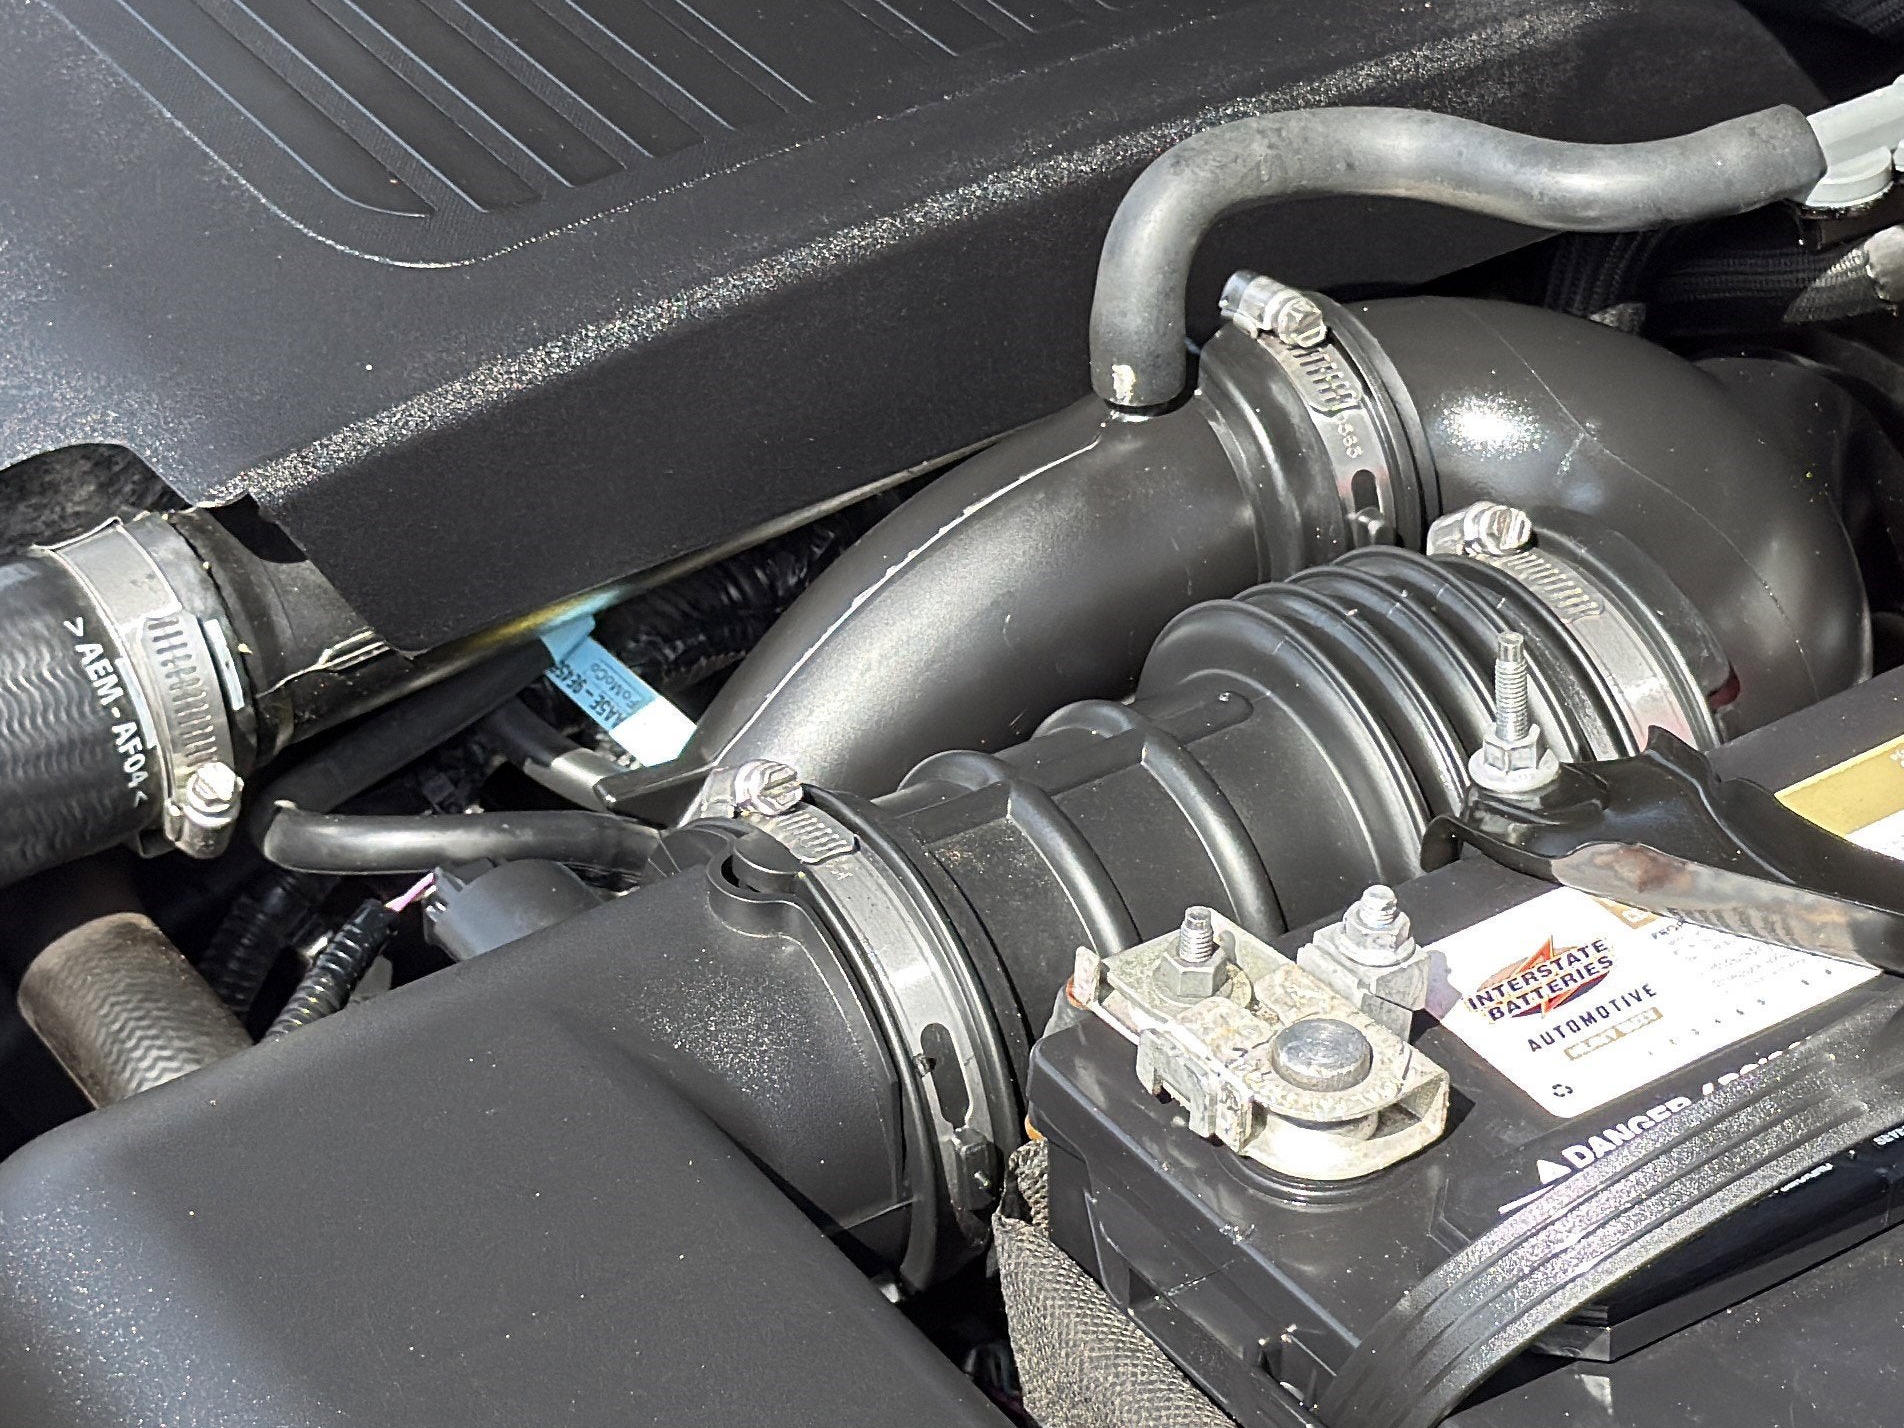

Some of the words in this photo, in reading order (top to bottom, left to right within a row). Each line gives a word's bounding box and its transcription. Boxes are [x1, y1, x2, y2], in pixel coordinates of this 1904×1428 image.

[590, 662, 641, 710] FoMoCo
[1466, 937, 1609, 1011] INTERSTATE
[1488, 954, 1614, 1021] BATTERIES
[1527, 982, 1657, 1053] AUTOMOTIVE
